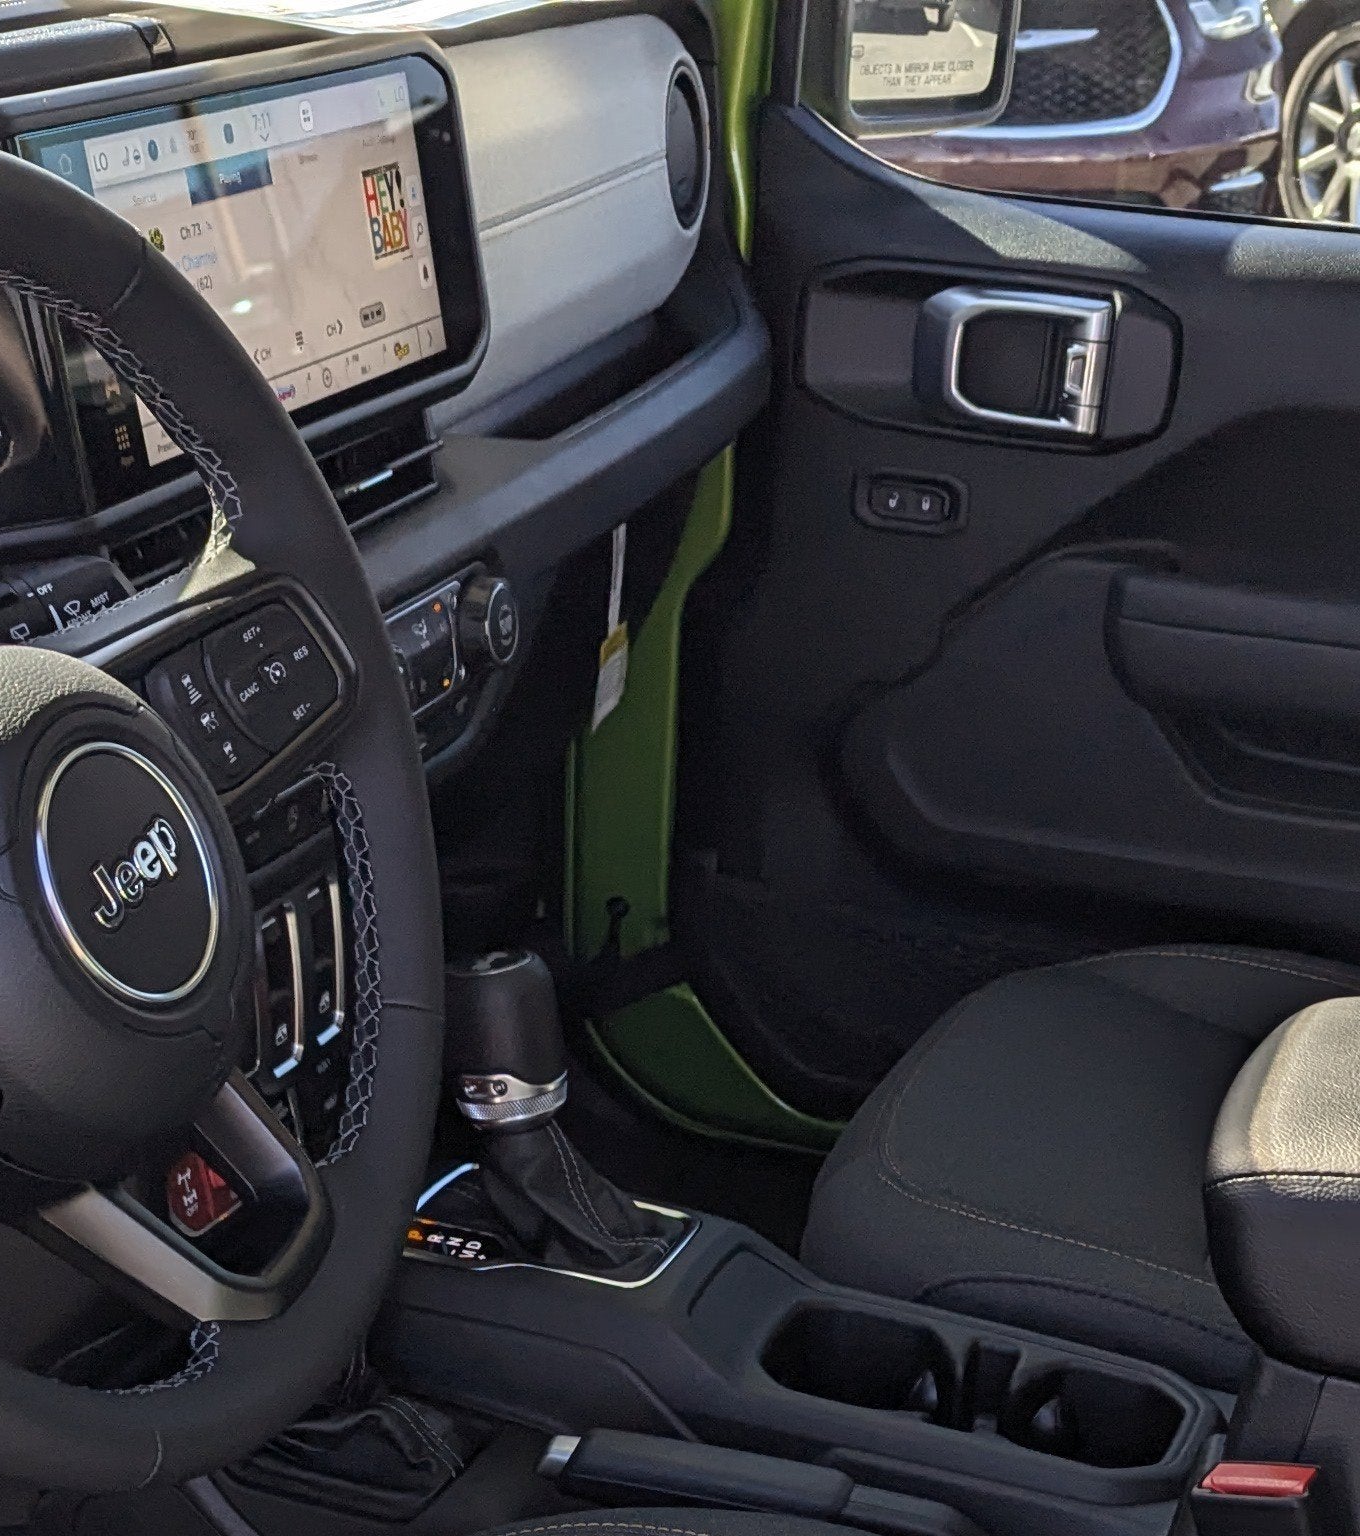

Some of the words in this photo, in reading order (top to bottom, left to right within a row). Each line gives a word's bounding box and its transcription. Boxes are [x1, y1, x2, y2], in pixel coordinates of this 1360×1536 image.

[860, 63, 892, 75] OBJECTS
[894, 63, 902, 74] IN
[904, 61, 930, 73] MIRROR
[932, 61, 945, 72] ARE
[947, 60, 975, 72] CLOSER
[883, 76, 900, 86] THAN
[905, 75, 921, 85] THEY
[924, 74, 952, 85] APPEAR
[252, 112, 271, 130] 7:11
[93, 152, 109, 173] LO
[363, 168, 405, 219] HEY!
[192, 223, 202, 236] 73
[370, 208, 410, 255] BABY
[36, 583, 54, 597] OFF
[293, 645, 309, 661] RES
[239, 682, 260, 703] CANC
[92, 815, 180, 928] Jeep
